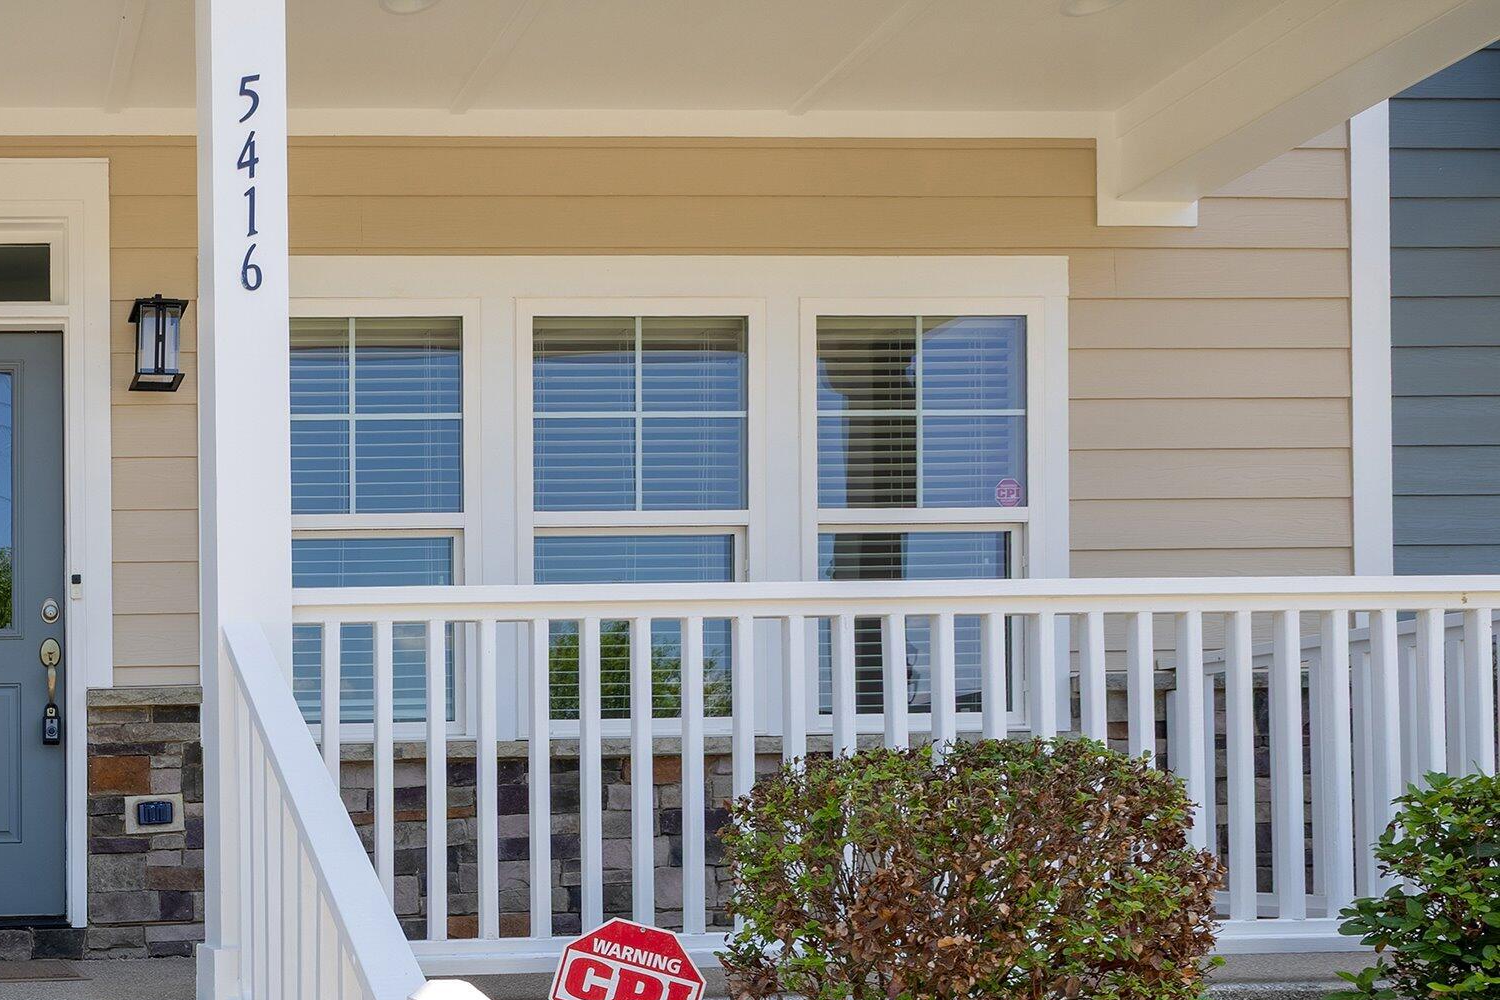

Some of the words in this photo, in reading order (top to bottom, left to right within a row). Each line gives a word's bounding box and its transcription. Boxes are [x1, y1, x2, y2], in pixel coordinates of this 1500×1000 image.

[237, 74, 263, 291] 5416
[997, 488, 1020, 498] CPI
[592, 938, 682, 974] WARNING
